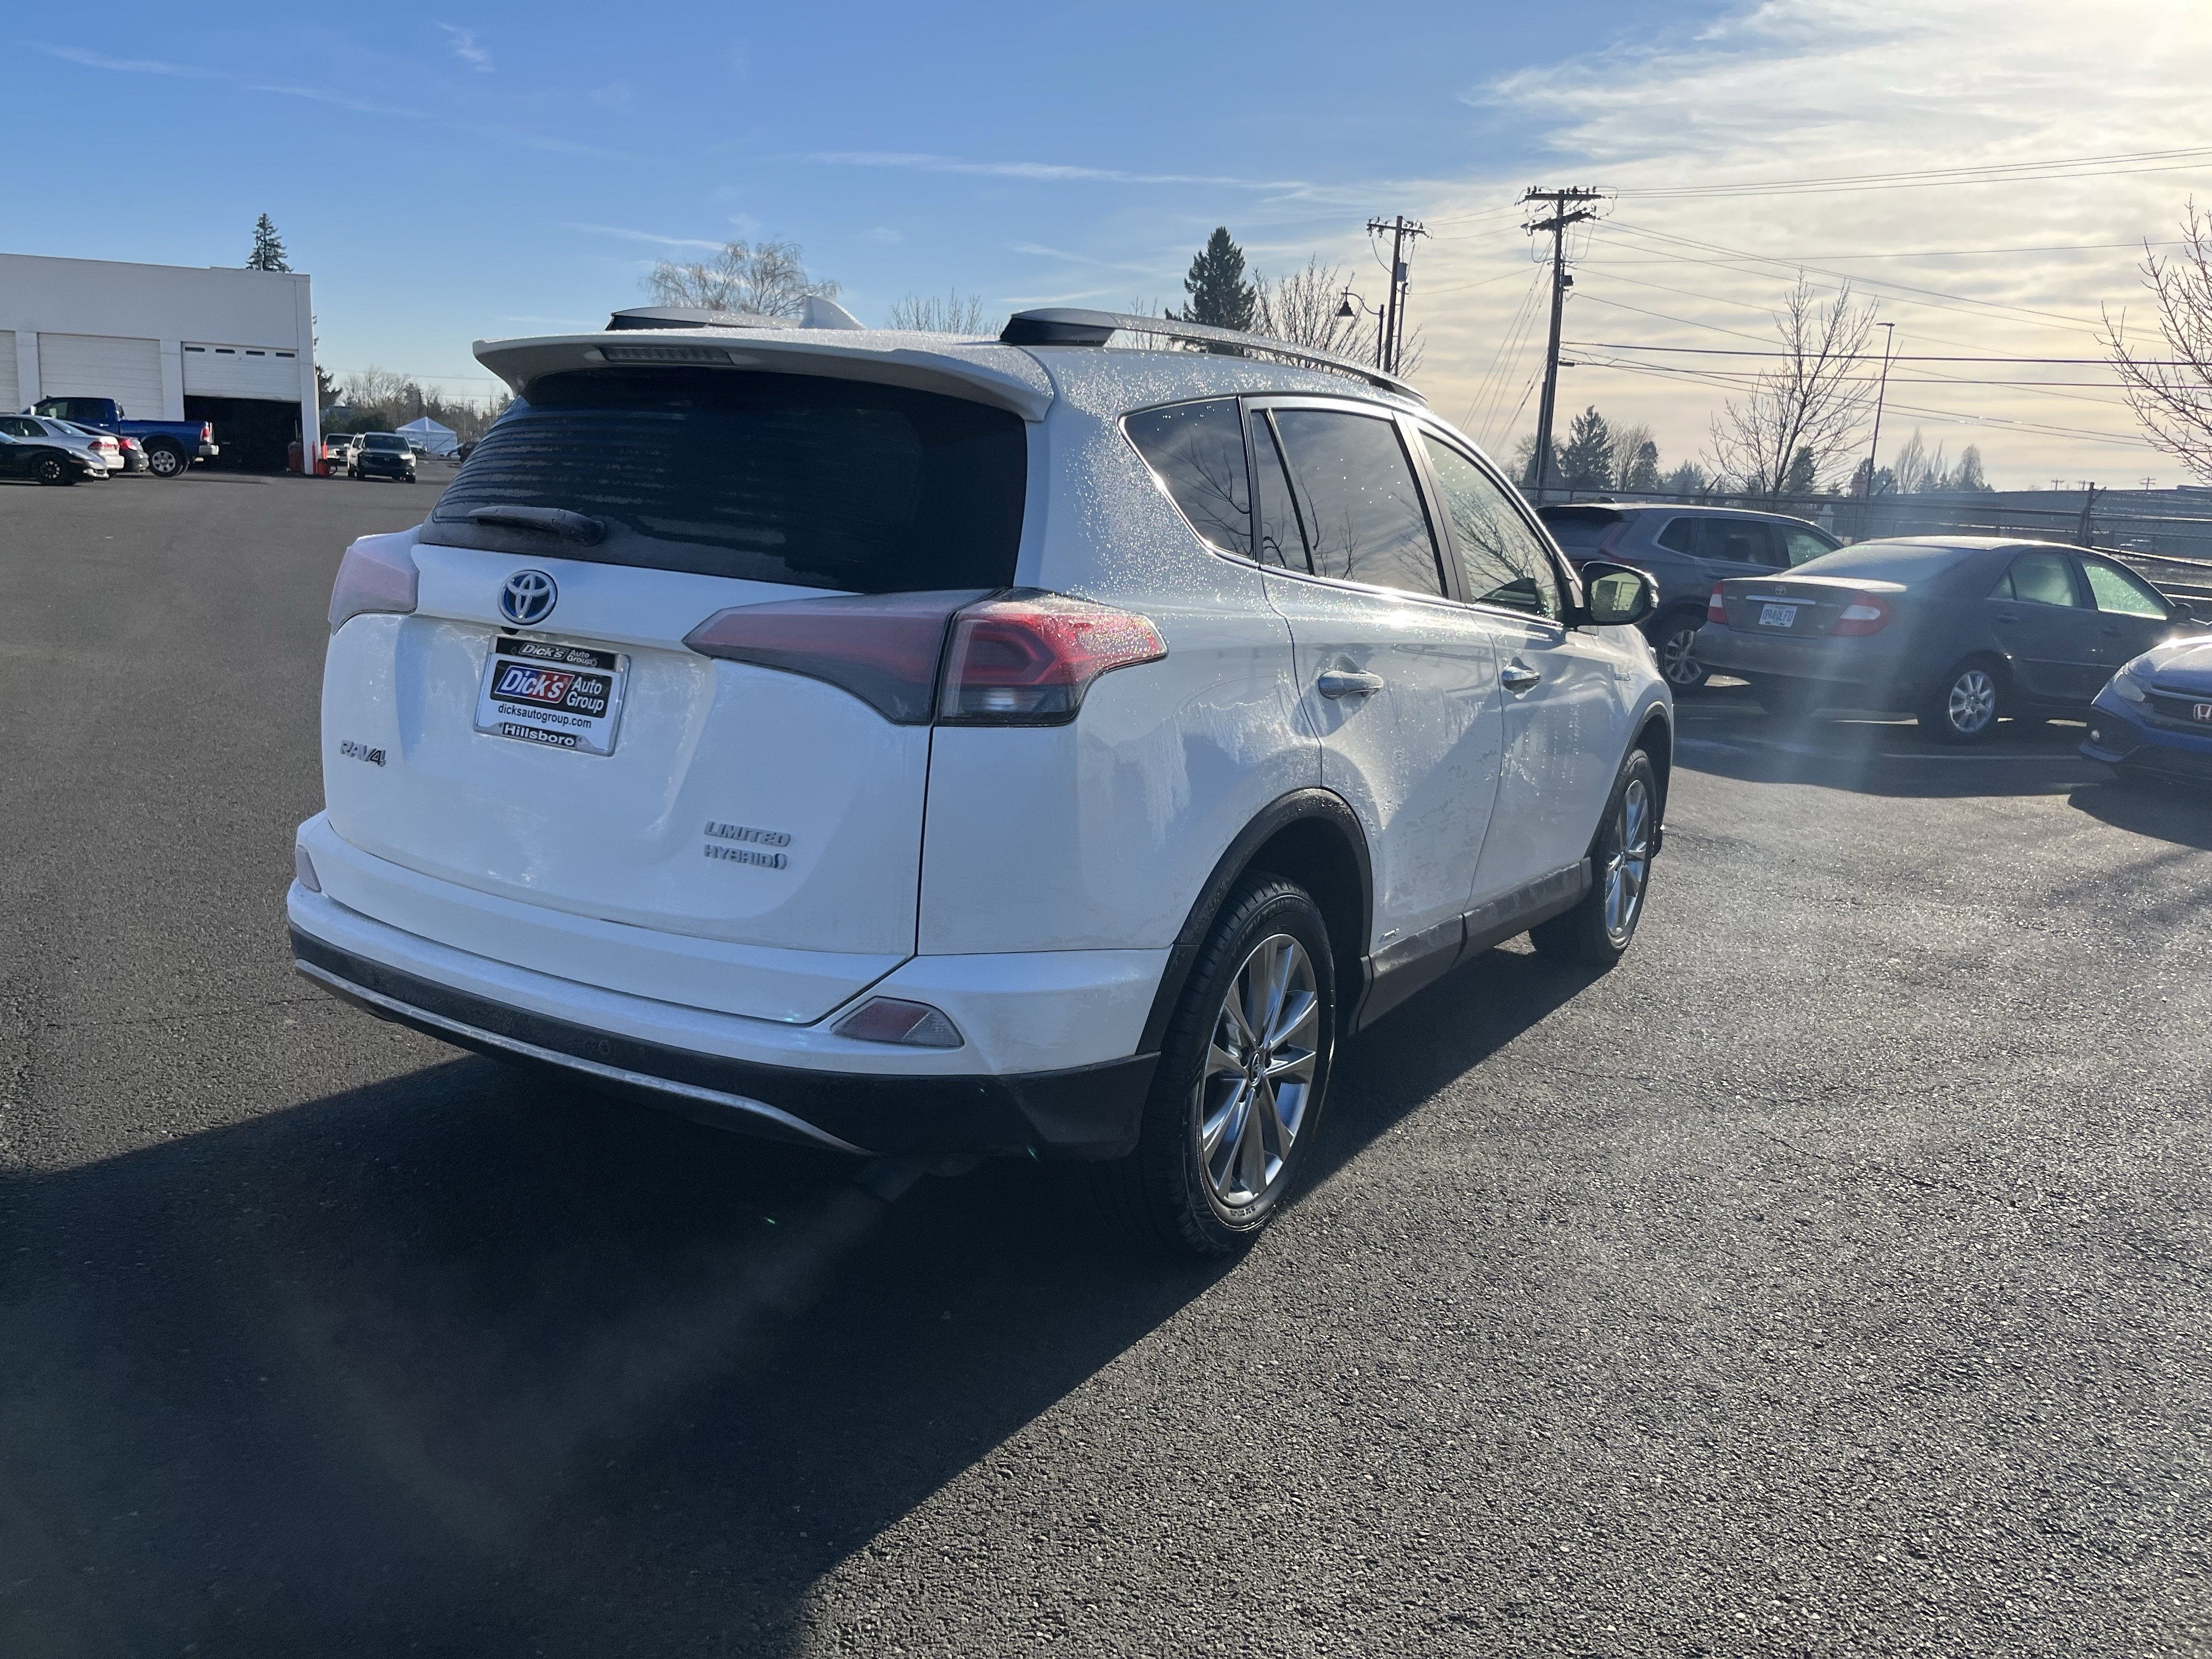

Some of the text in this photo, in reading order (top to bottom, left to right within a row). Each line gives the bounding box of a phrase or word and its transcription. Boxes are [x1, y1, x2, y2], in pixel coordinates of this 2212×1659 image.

[522, 645, 565, 658] Dick's
[567, 655, 593, 665] Group
[569, 650, 590, 658] Auto
[500, 670, 564, 699] Dick's
[571, 676, 602, 695] Auto
[566, 692, 604, 713] Group
[498, 703, 591, 728] dicksautogroup.com
[504, 724, 575, 746] Hillsboro
[340, 740, 386, 767] RAV4
[704, 821, 792, 847] LIMITED
[704, 844, 774, 867] HYBRID
